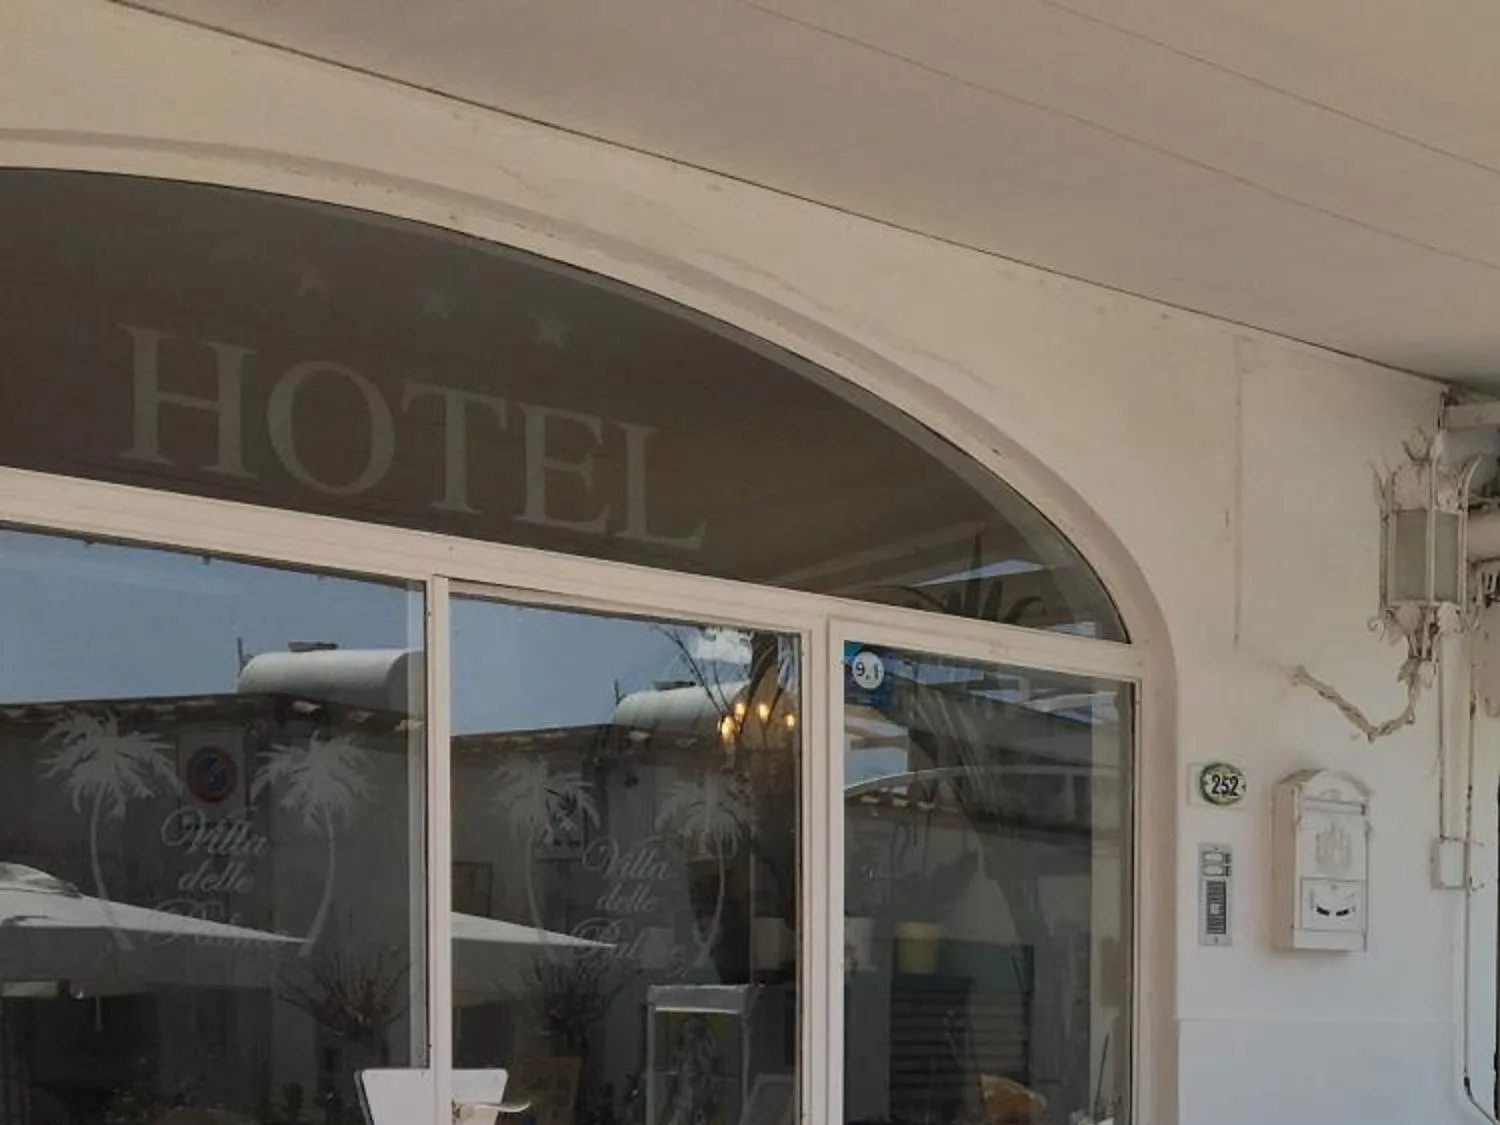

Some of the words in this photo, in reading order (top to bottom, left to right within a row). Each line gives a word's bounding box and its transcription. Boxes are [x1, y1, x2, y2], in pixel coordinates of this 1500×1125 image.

[117, 323, 708, 550] HOTEL
[1211, 773, 1239, 796] 252
[161, 805, 272, 856] Villa
[178, 859, 256, 893] delle
[582, 834, 673, 880] Villa
[595, 883, 659, 914] delle
